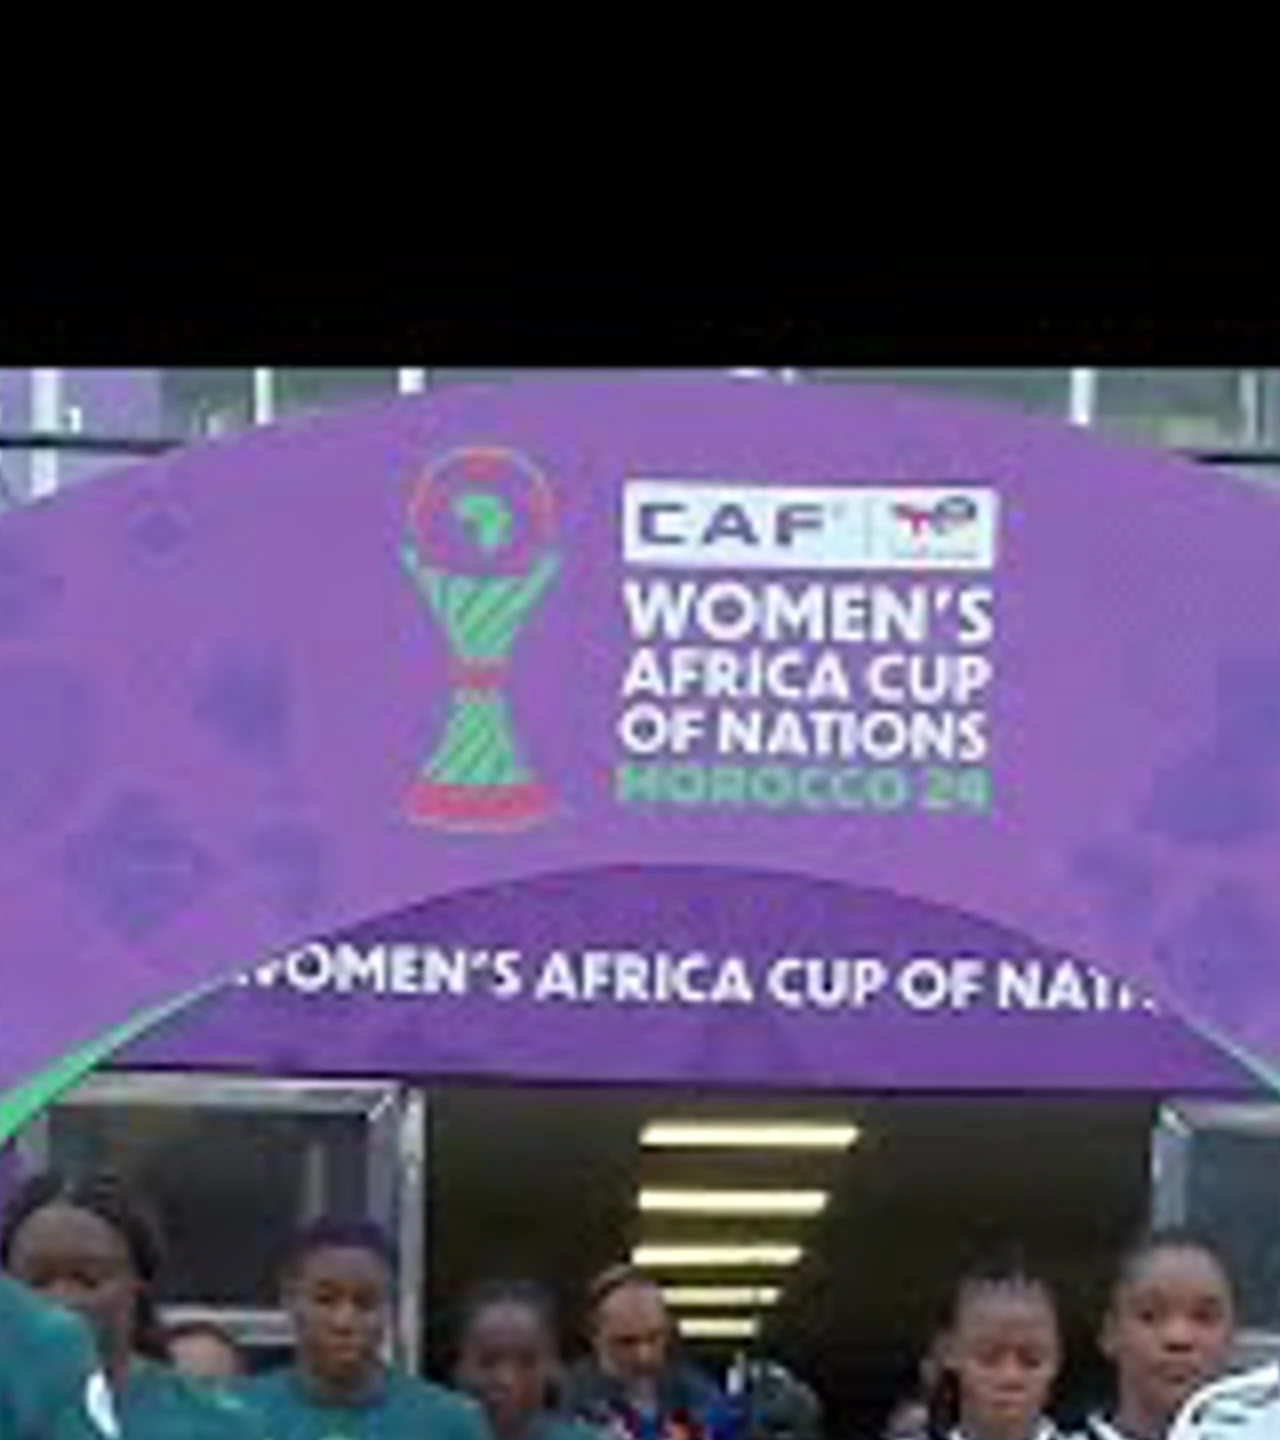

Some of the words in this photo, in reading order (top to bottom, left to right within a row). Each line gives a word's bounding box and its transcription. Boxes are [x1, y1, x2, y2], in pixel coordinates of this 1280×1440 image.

[638, 502, 825, 546] CAF
[624, 581, 993, 643] WOMEN'S
[623, 647, 850, 699] AFRICA
[867, 654, 993, 704] CUP
[620, 703, 705, 754] OF
[718, 710, 987, 762] NATIONS
[622, 766, 910, 810] MOROCCO
[535, 951, 753, 1001] AFRICA
[767, 958, 888, 1008] CUP
[897, 958, 984, 1009] OF
